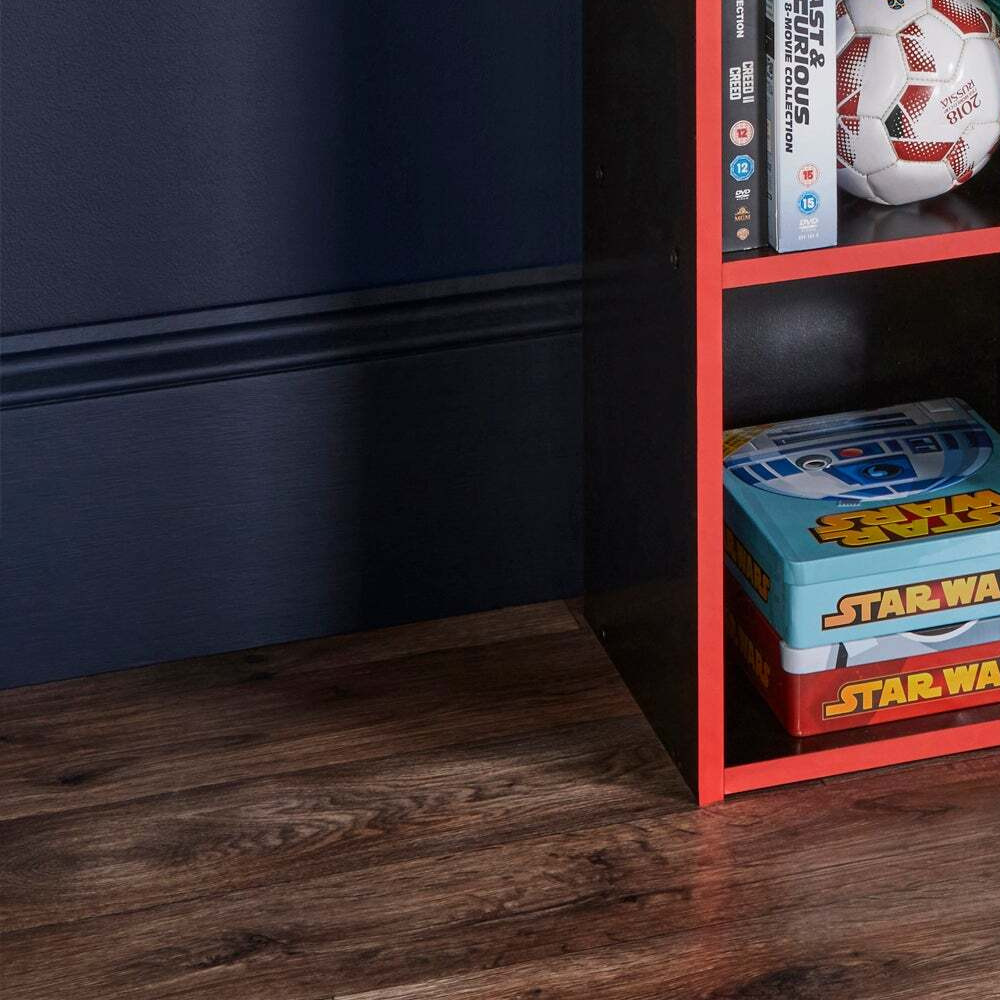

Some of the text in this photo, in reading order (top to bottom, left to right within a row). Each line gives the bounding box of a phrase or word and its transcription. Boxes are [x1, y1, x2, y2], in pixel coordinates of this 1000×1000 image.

[808, 48, 825, 69] &
[729, 66, 742, 101] CREED
[742, 60, 755, 104] CREED II
[784, 2, 793, 154] 8-MOVIE COLLECTION
[940, 79, 976, 108] RUSSIA
[946, 92, 982, 125] 2018
[736, 128, 748, 139] 12
[736, 162, 748, 174] 12
[803, 170, 813, 180] 15
[803, 197, 814, 209] 15
[823, 583, 942, 630] STAR
[825, 671, 943, 719] STAR
